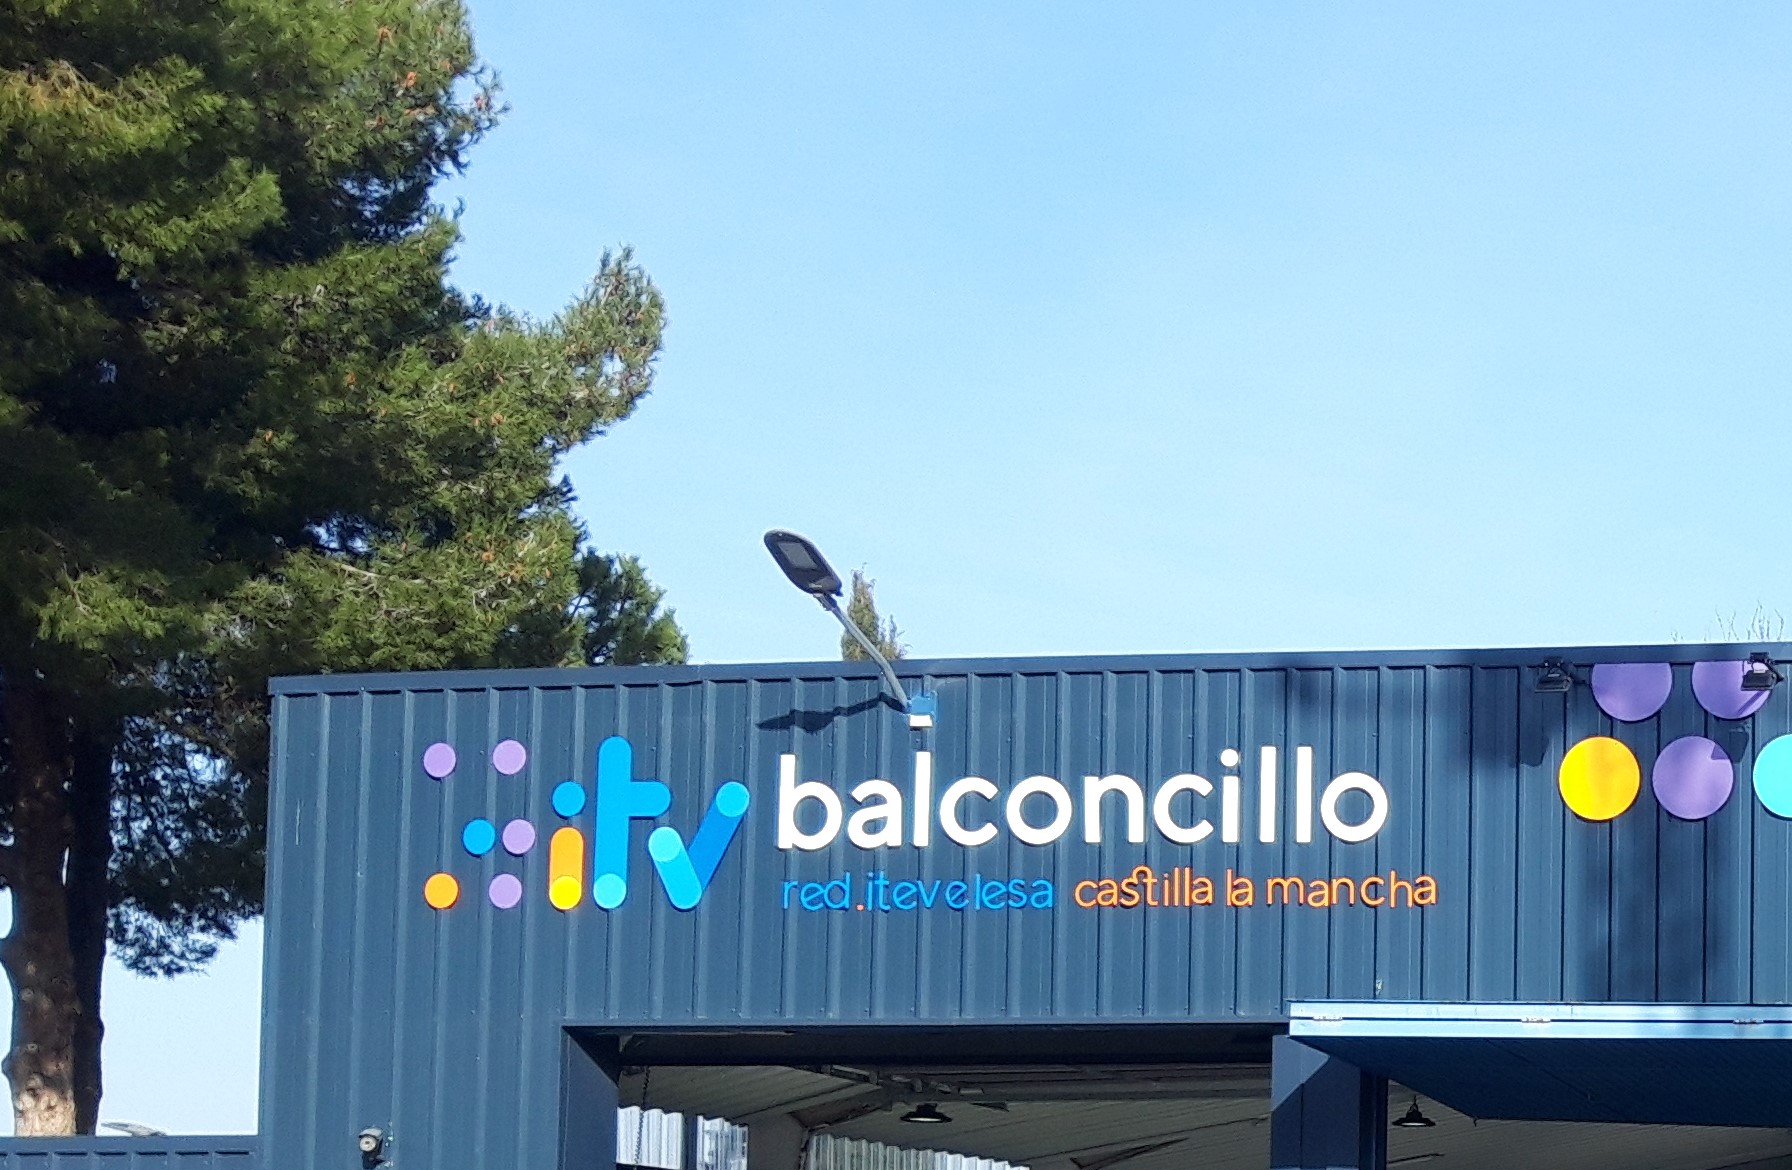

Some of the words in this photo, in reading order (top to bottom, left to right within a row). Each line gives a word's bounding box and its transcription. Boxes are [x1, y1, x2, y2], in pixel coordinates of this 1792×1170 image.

[550, 735, 752, 909] itv
[776, 746, 1388, 850] balconcillo
[780, 869, 1055, 912] red.itevelesa
[1074, 865, 1214, 909] castilla
[1226, 869, 1255, 908] la
[1267, 870, 1438, 908] mancha
